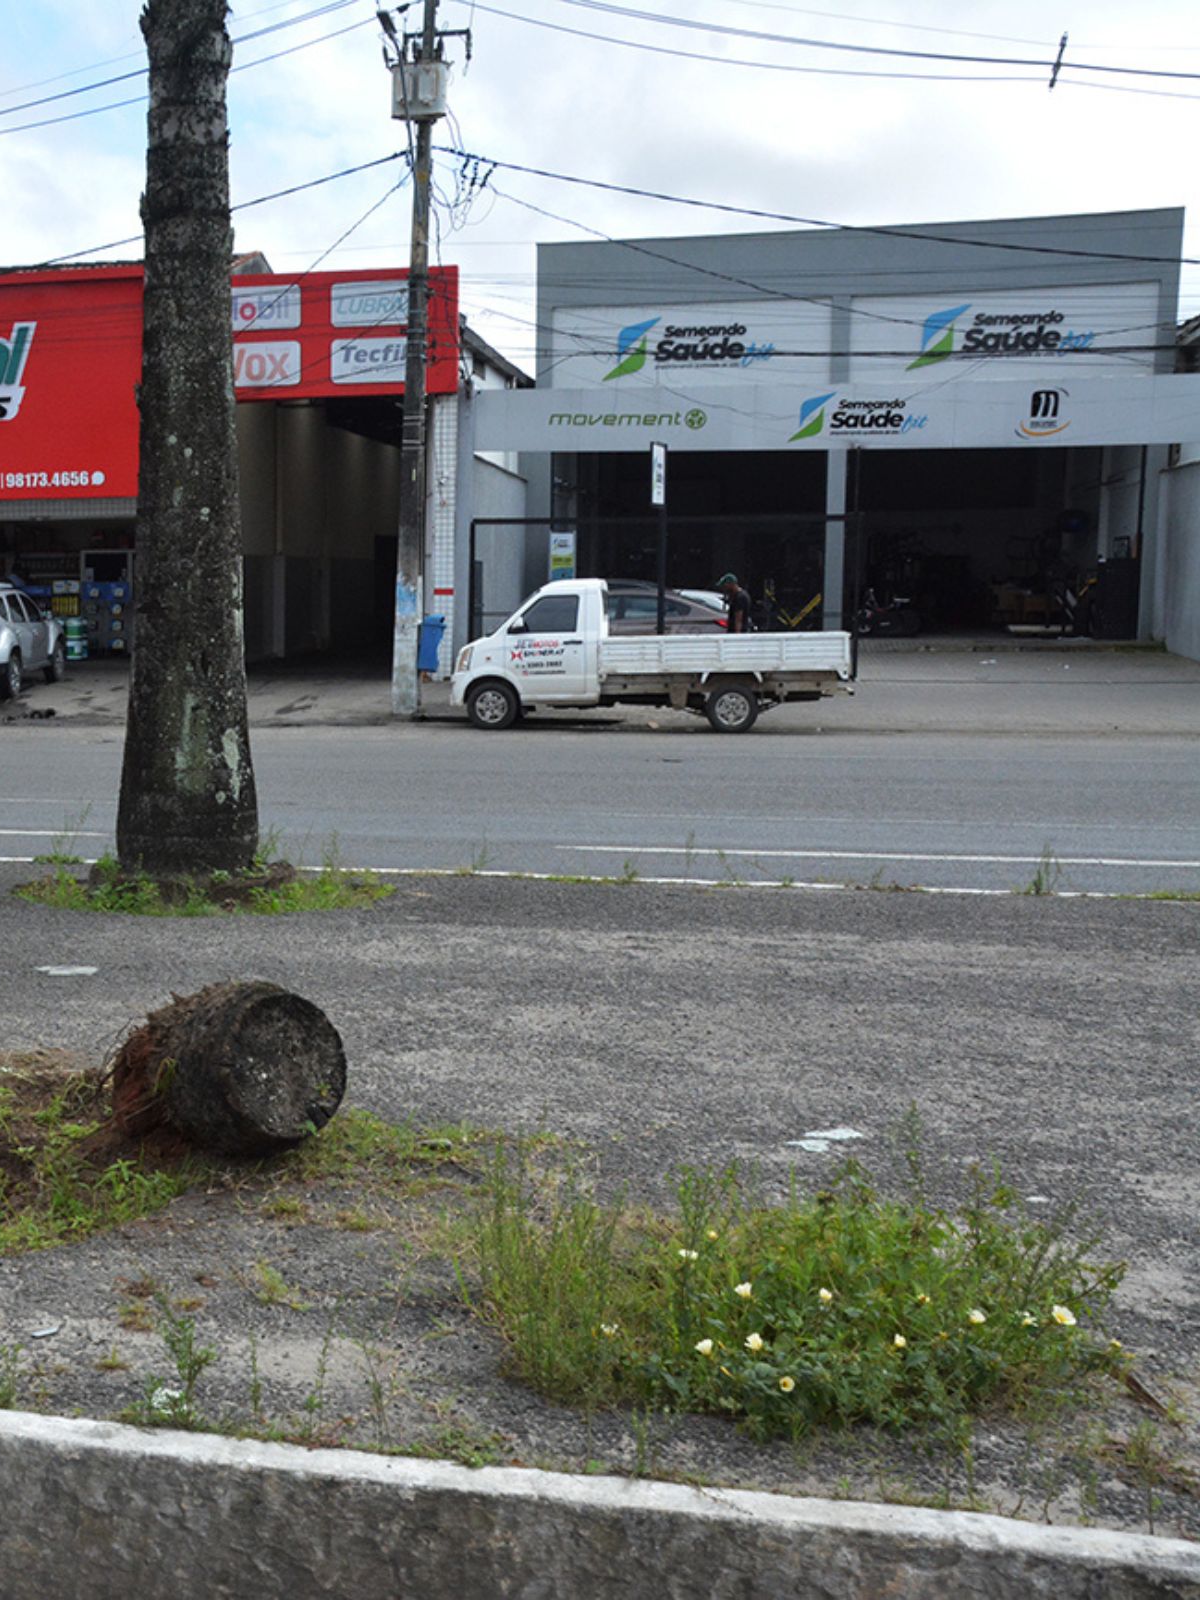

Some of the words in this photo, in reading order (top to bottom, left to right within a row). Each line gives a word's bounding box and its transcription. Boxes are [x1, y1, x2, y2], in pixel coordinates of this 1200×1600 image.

[972, 309, 1065, 326] Semeando
[664, 322, 747, 338] Semeando
[962, 325, 1061, 352] Saúde
[654, 337, 746, 363] Saúde
[838, 398, 906, 409] Semeando
[548, 410, 681, 426] movement
[829, 409, 904, 429] Saúde
